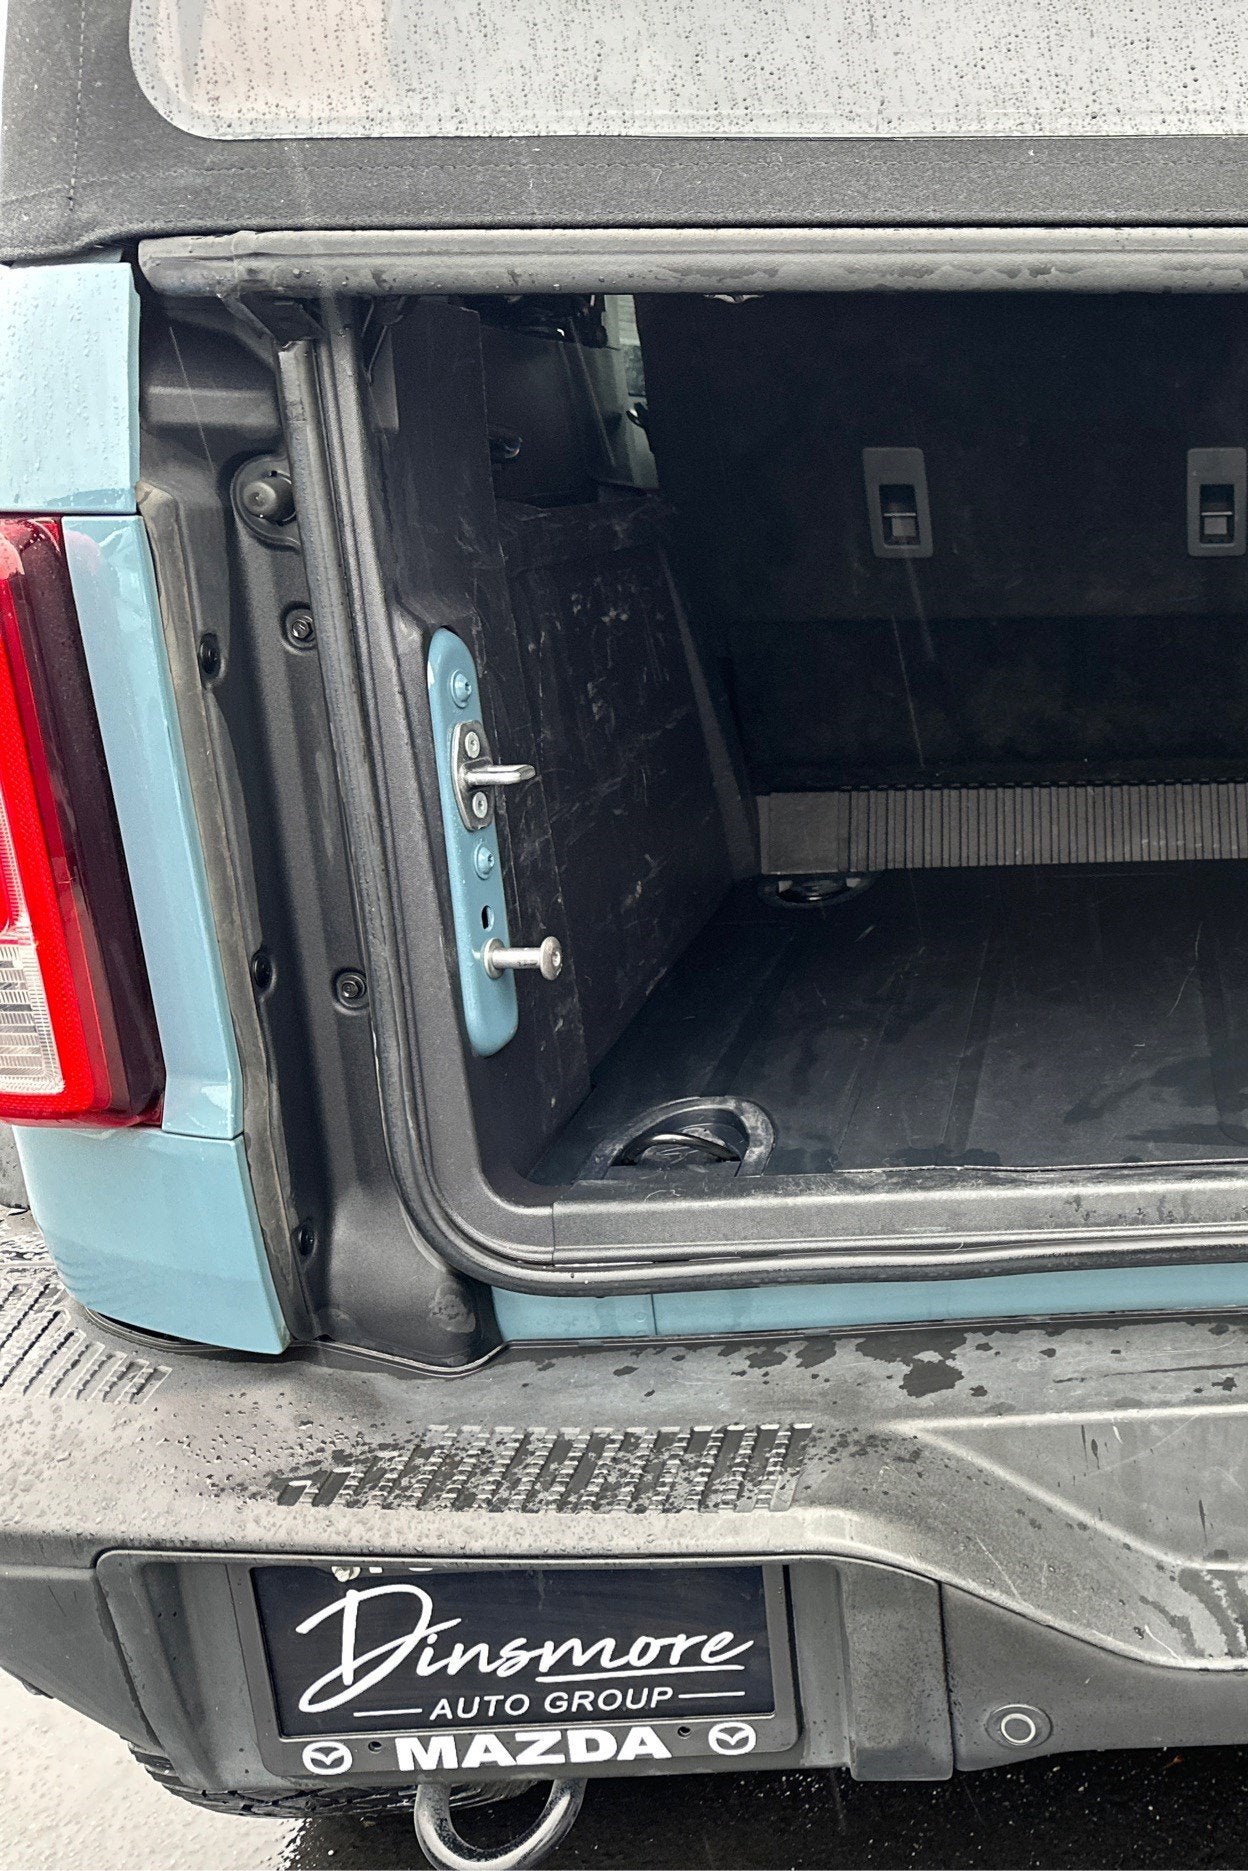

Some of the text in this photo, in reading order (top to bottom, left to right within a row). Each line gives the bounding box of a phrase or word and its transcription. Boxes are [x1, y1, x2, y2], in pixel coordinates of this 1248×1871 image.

[295, 1583, 755, 1713] Dinsmore
[429, 1686, 675, 1721] AUTO GROUP
[394, 1725, 674, 1772] MAZDA
